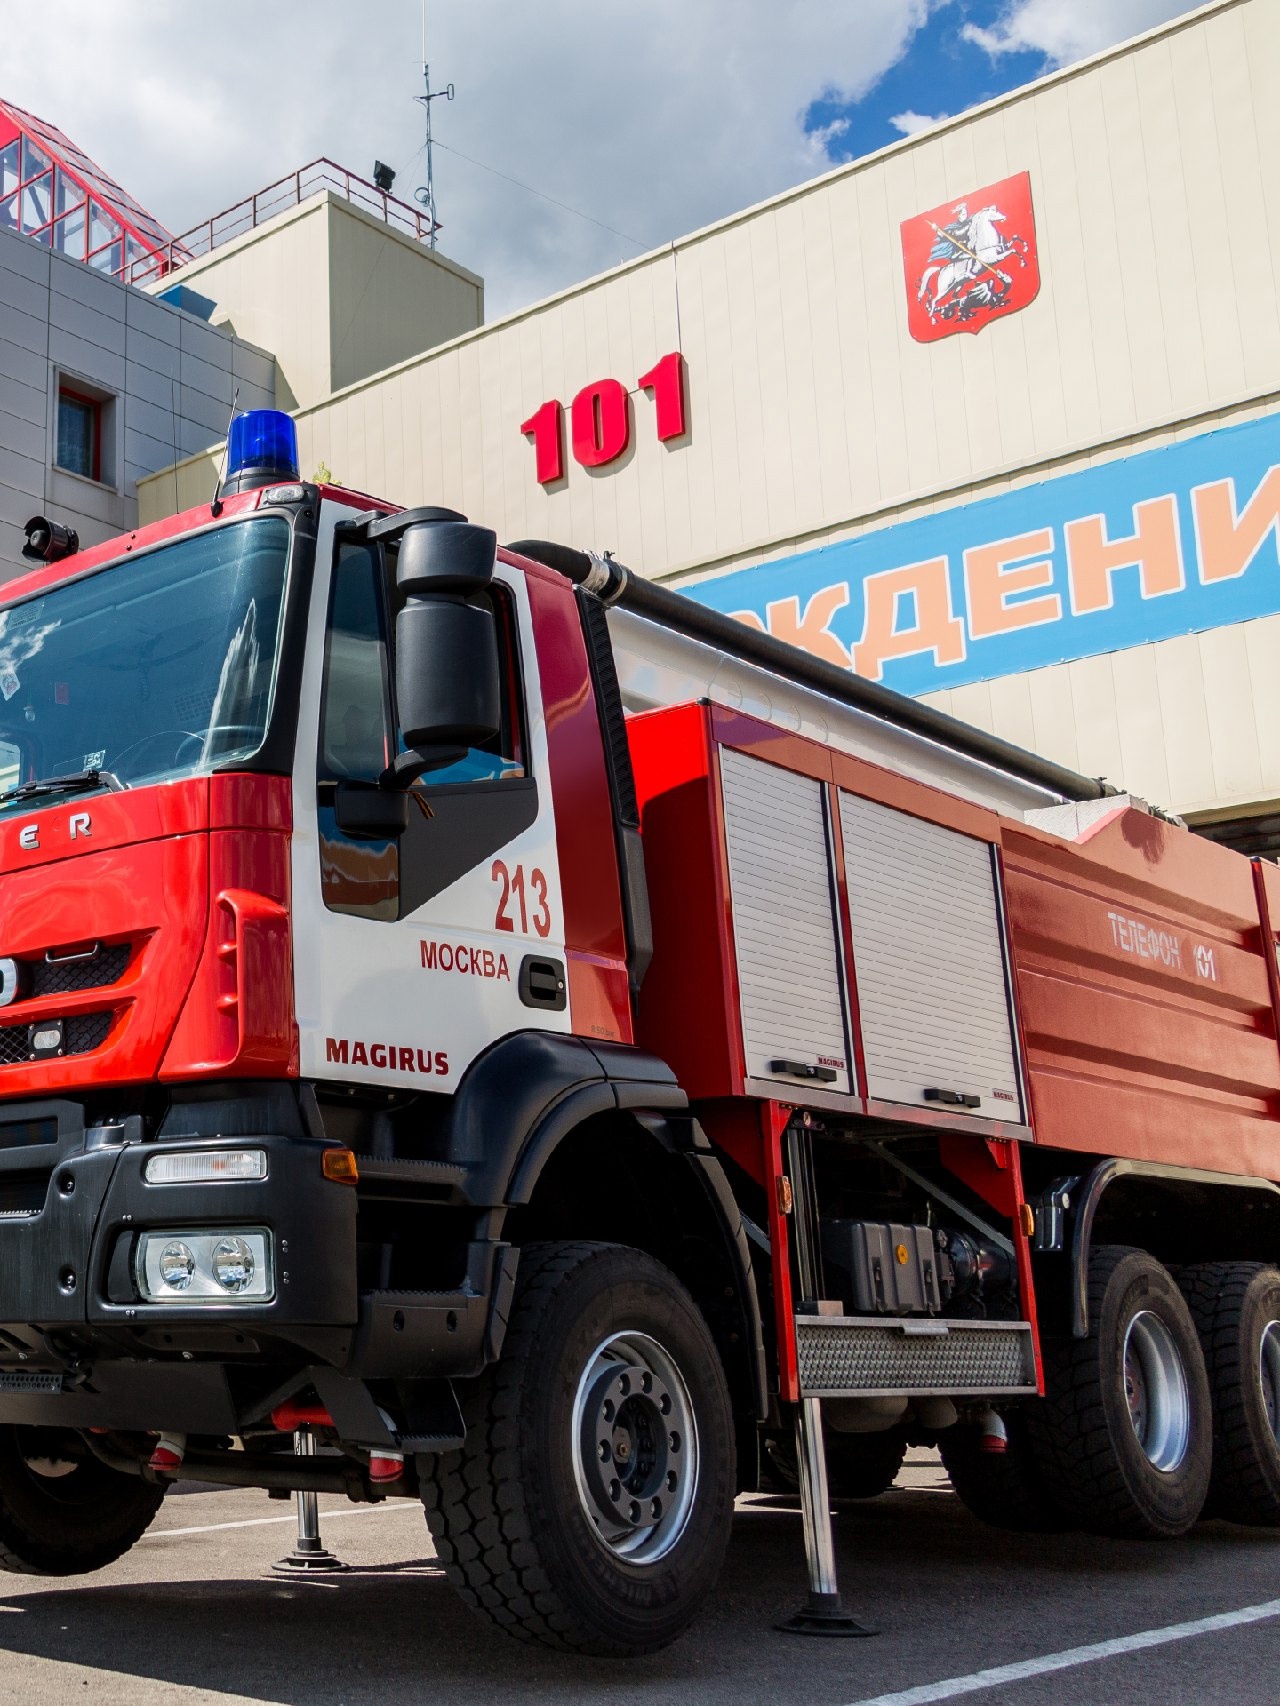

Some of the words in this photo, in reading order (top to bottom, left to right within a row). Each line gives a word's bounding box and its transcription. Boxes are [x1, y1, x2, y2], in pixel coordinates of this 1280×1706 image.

[520, 352, 686, 484] 101
[491, 859, 551, 938] 213
[420, 939, 511, 982] МОСКВА
[1107, 911, 1181, 970] ТЕЛЕФОН
[325, 1037, 450, 1076] MAGIRUS
[818, 1057, 845, 1069] MAGIRUS
